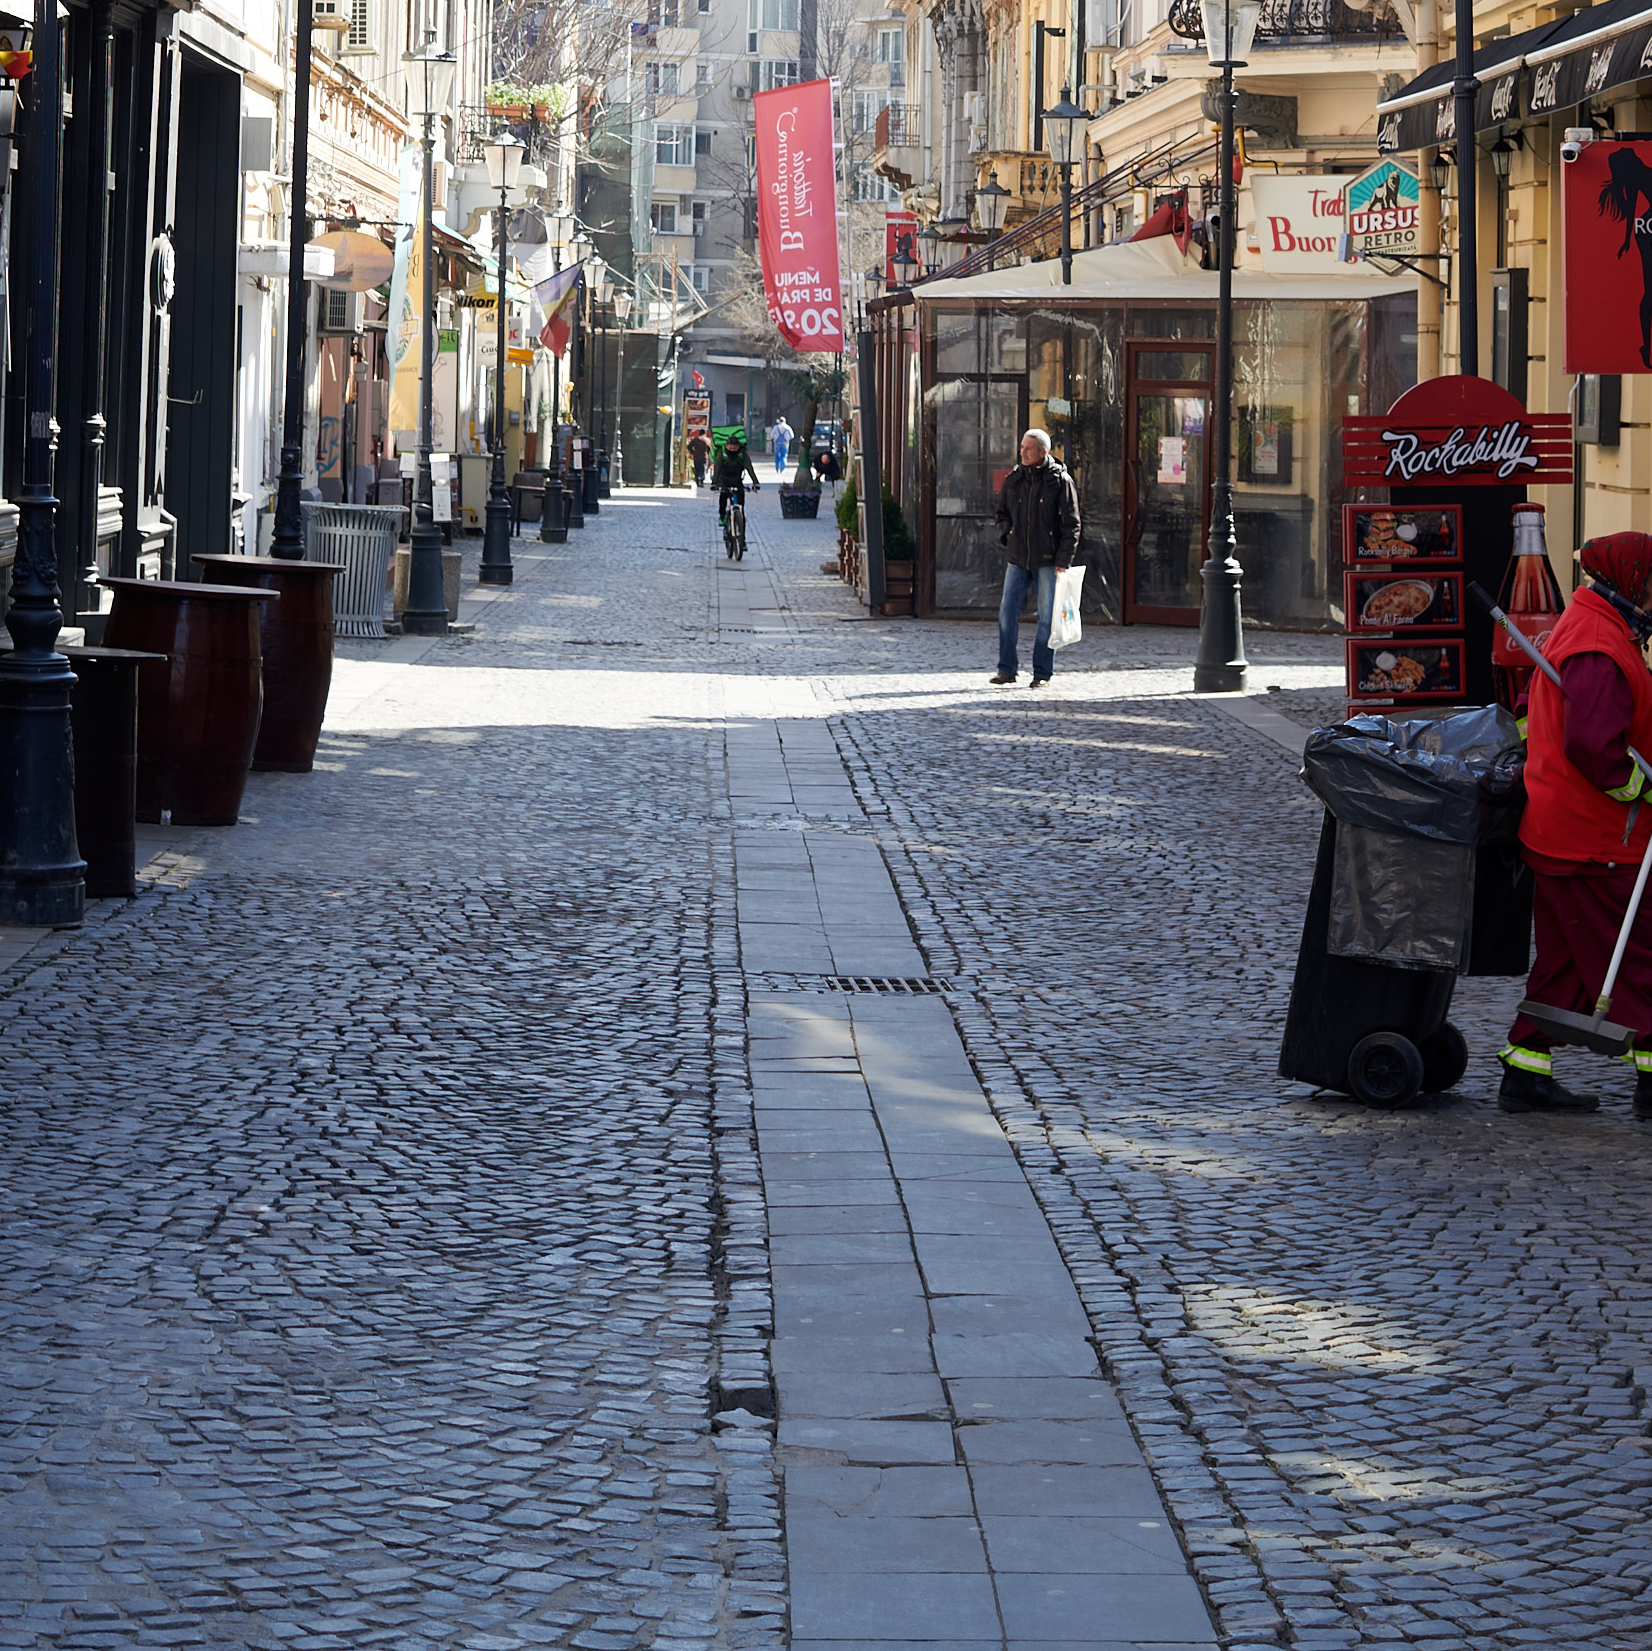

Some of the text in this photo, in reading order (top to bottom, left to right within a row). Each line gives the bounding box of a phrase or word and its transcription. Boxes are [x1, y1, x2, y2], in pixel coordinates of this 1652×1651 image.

[1365, 230, 1416, 247] RETRO
[457, 295, 496, 308] Nikon
[1382, 421, 1538, 480] Rockabilly
